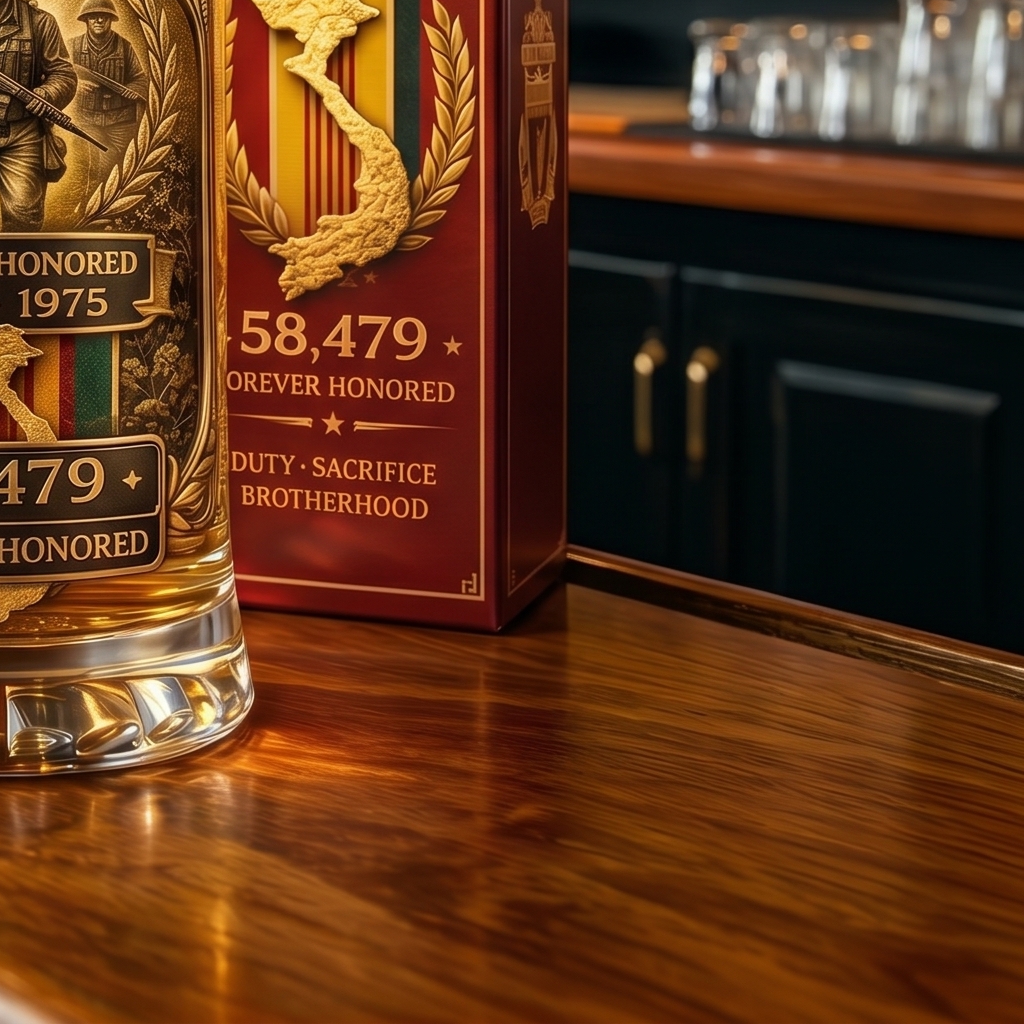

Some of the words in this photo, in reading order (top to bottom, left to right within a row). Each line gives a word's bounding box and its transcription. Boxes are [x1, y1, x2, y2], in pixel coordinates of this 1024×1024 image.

[19, 288, 109, 318] 1975
[240, 310, 428, 364] 58,479
[226, 370, 321, 396] OREVER
[328, 376, 456, 403] HONORED
[231, 451, 296, 475] DUTY
[312, 456, 437, 485] SACRIFICE
[241, 485, 429, 520] BROTHERHOOD
